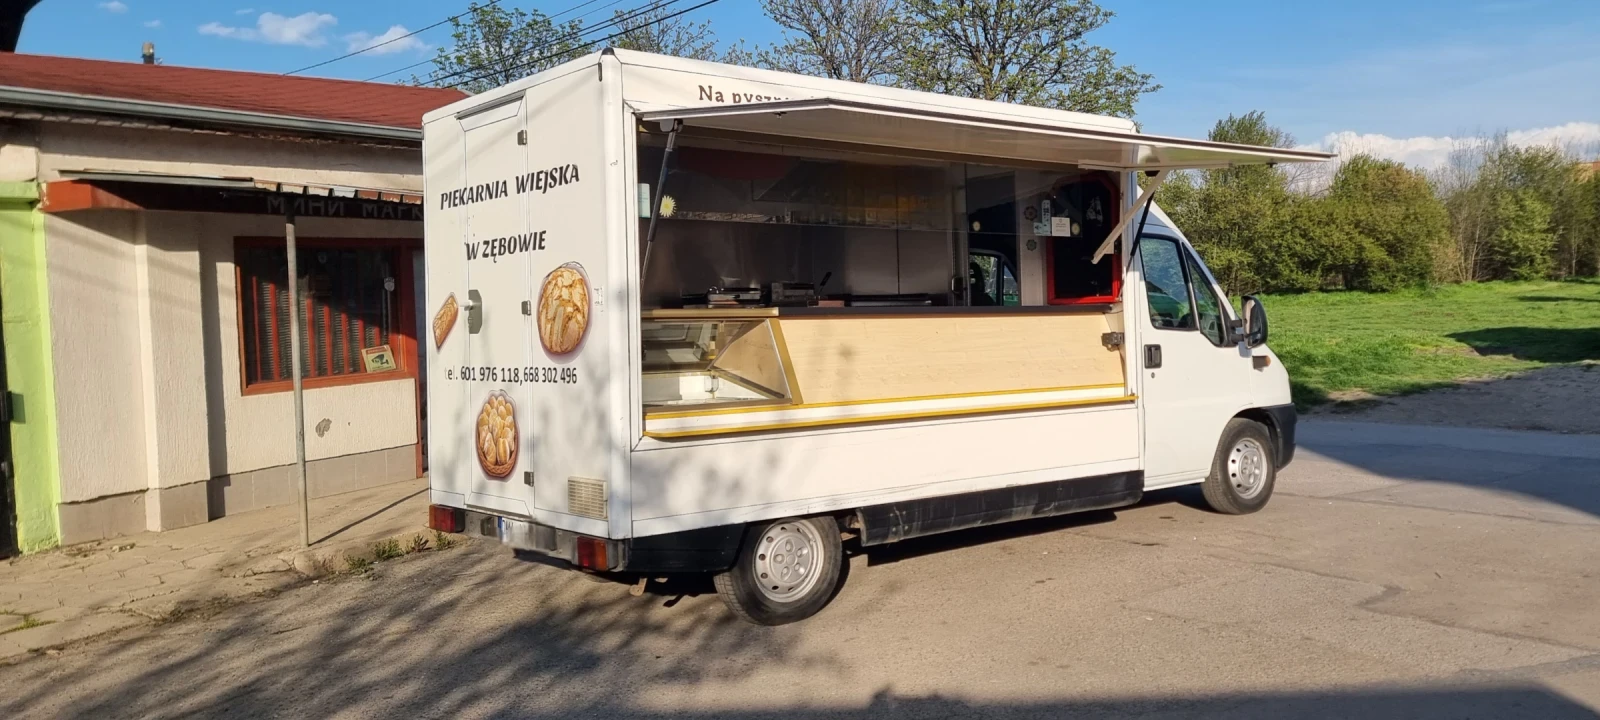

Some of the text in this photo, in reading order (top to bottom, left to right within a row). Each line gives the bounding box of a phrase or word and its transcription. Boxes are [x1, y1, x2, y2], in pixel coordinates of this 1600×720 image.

[698, 85, 725, 103] Na
[440, 163, 580, 210] PIEKARNIA WIEJSKA
[266, 195, 345, 216] МИНИ
[464, 230, 547, 263] W ZĘBOWIE
[460, 365, 477, 381] 601
[479, 366, 498, 382] 976
[541, 367, 558, 383] 302
[560, 367, 578, 384] 496
